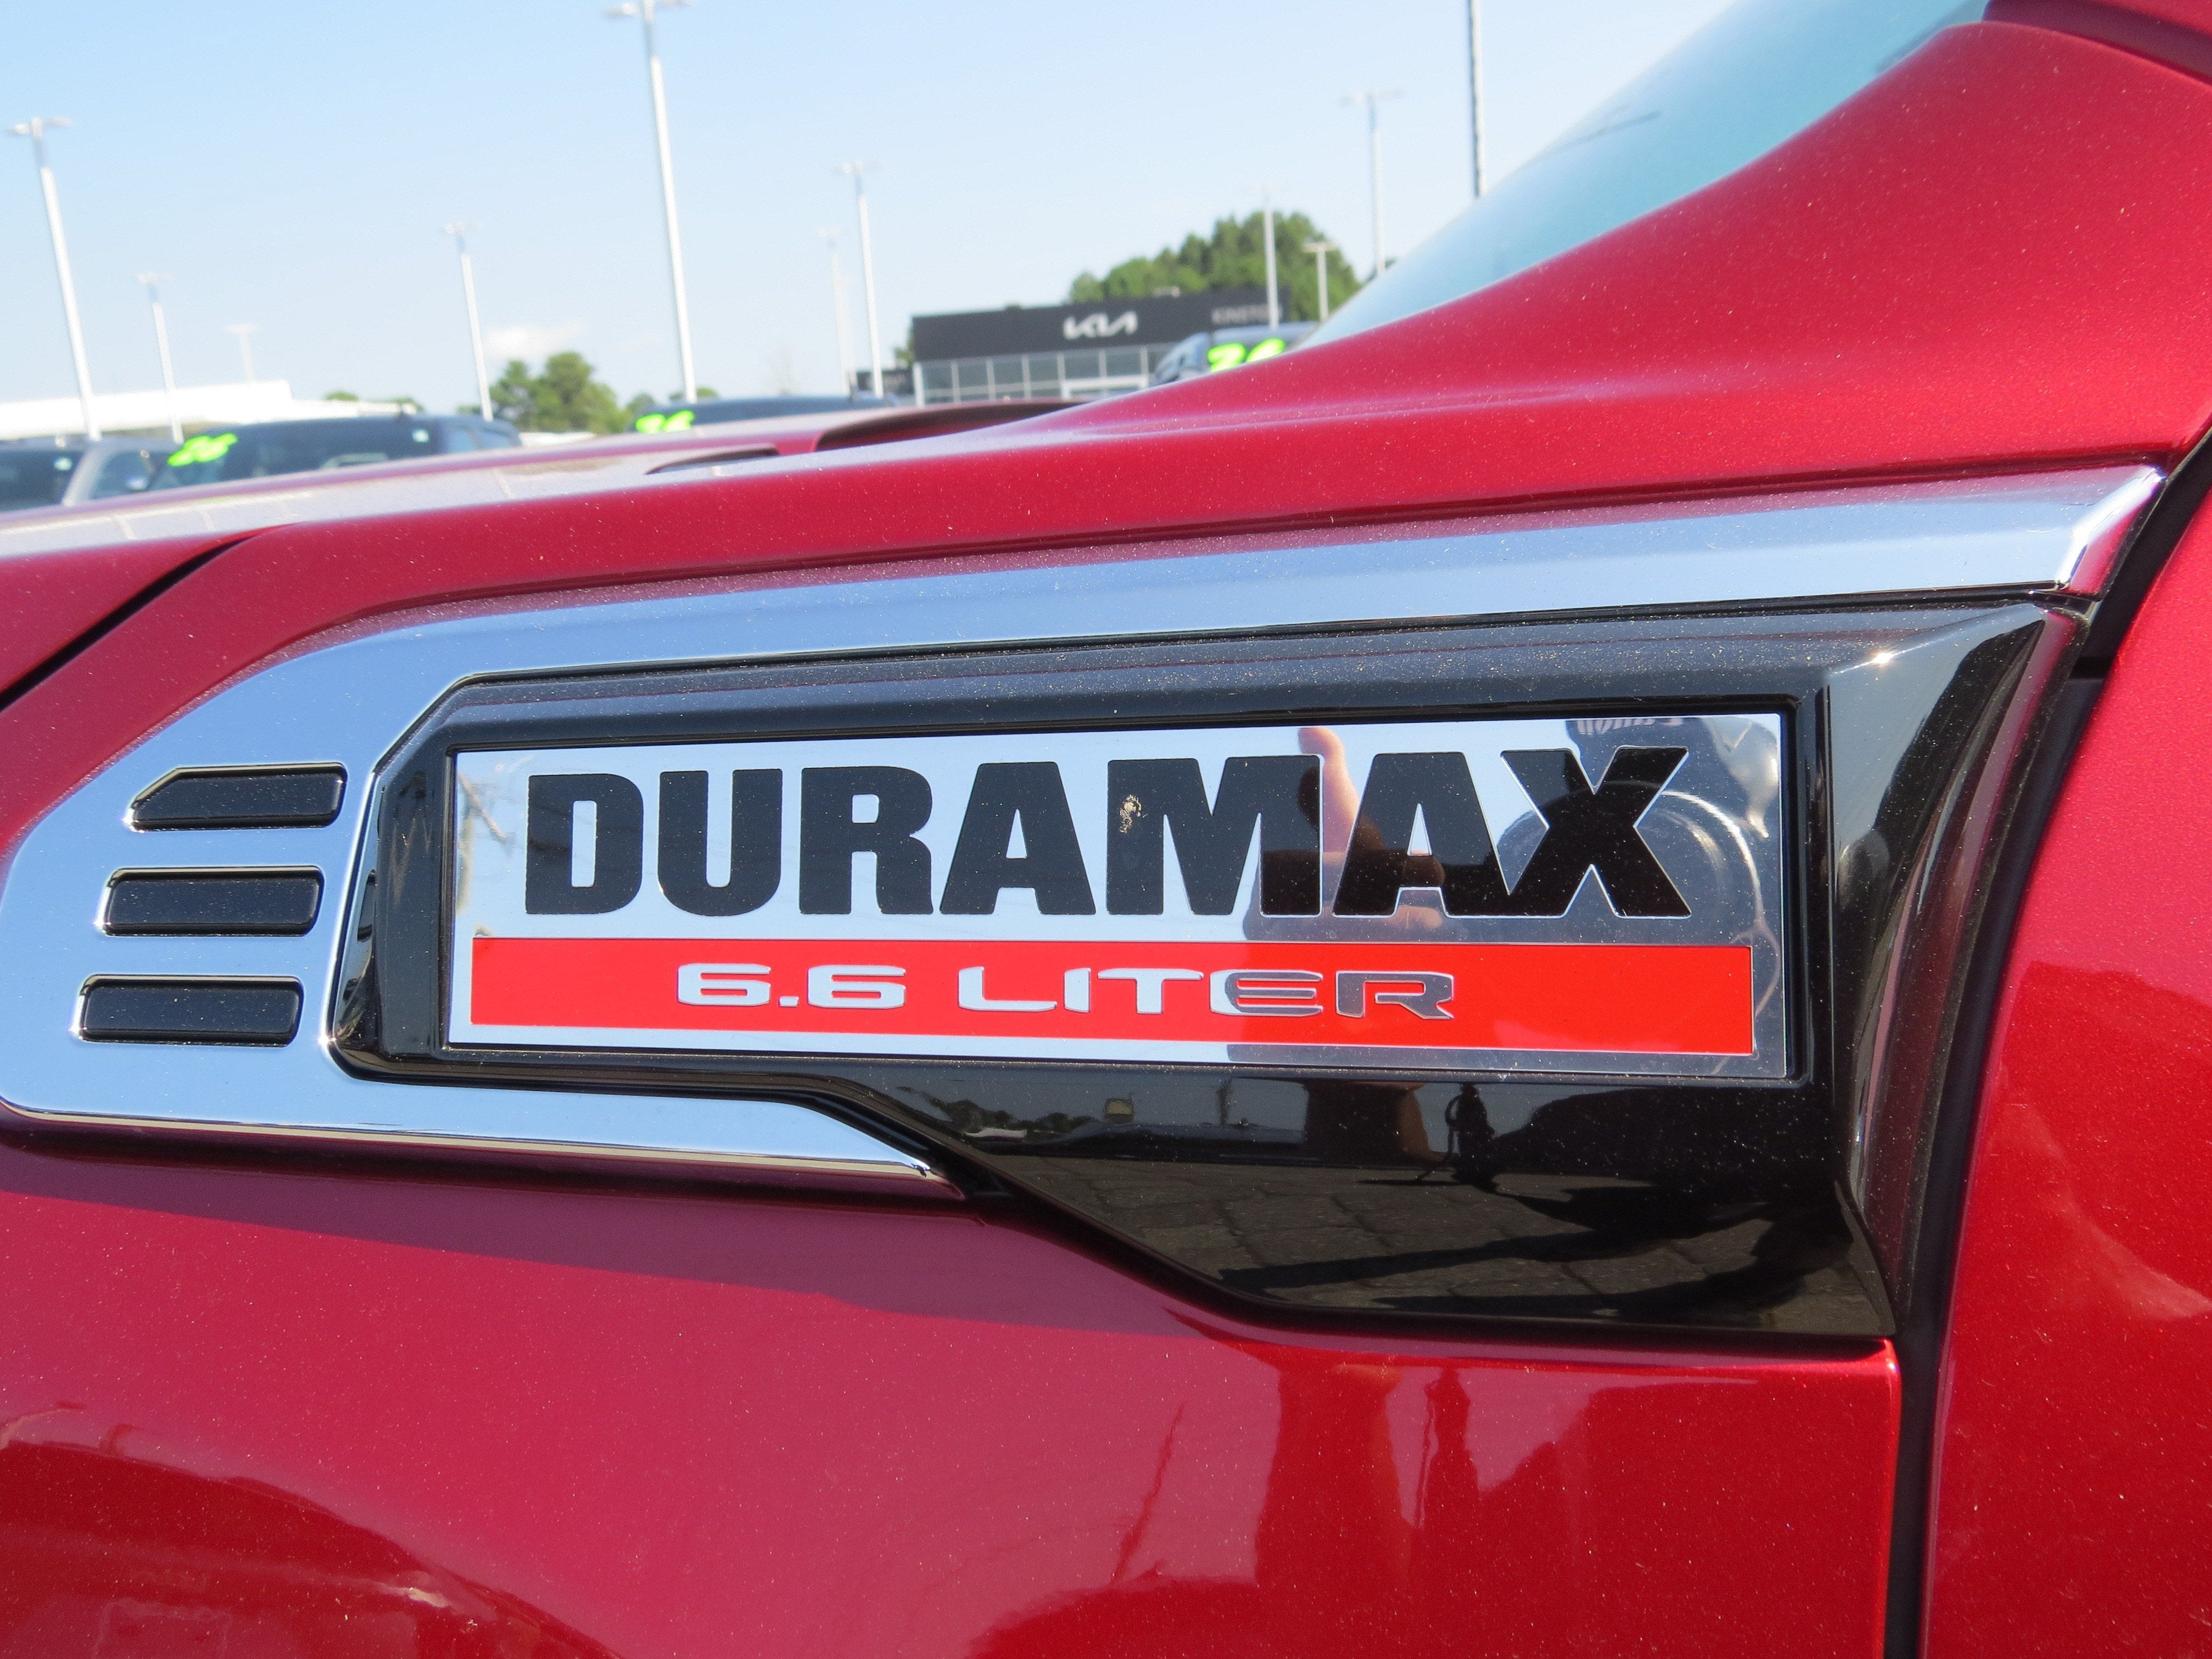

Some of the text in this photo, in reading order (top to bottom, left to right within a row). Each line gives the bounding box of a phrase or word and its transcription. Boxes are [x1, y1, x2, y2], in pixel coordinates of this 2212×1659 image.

[525, 746, 1692, 917] DURAMAX
[677, 962, 1454, 1020] 6.6 LITER
